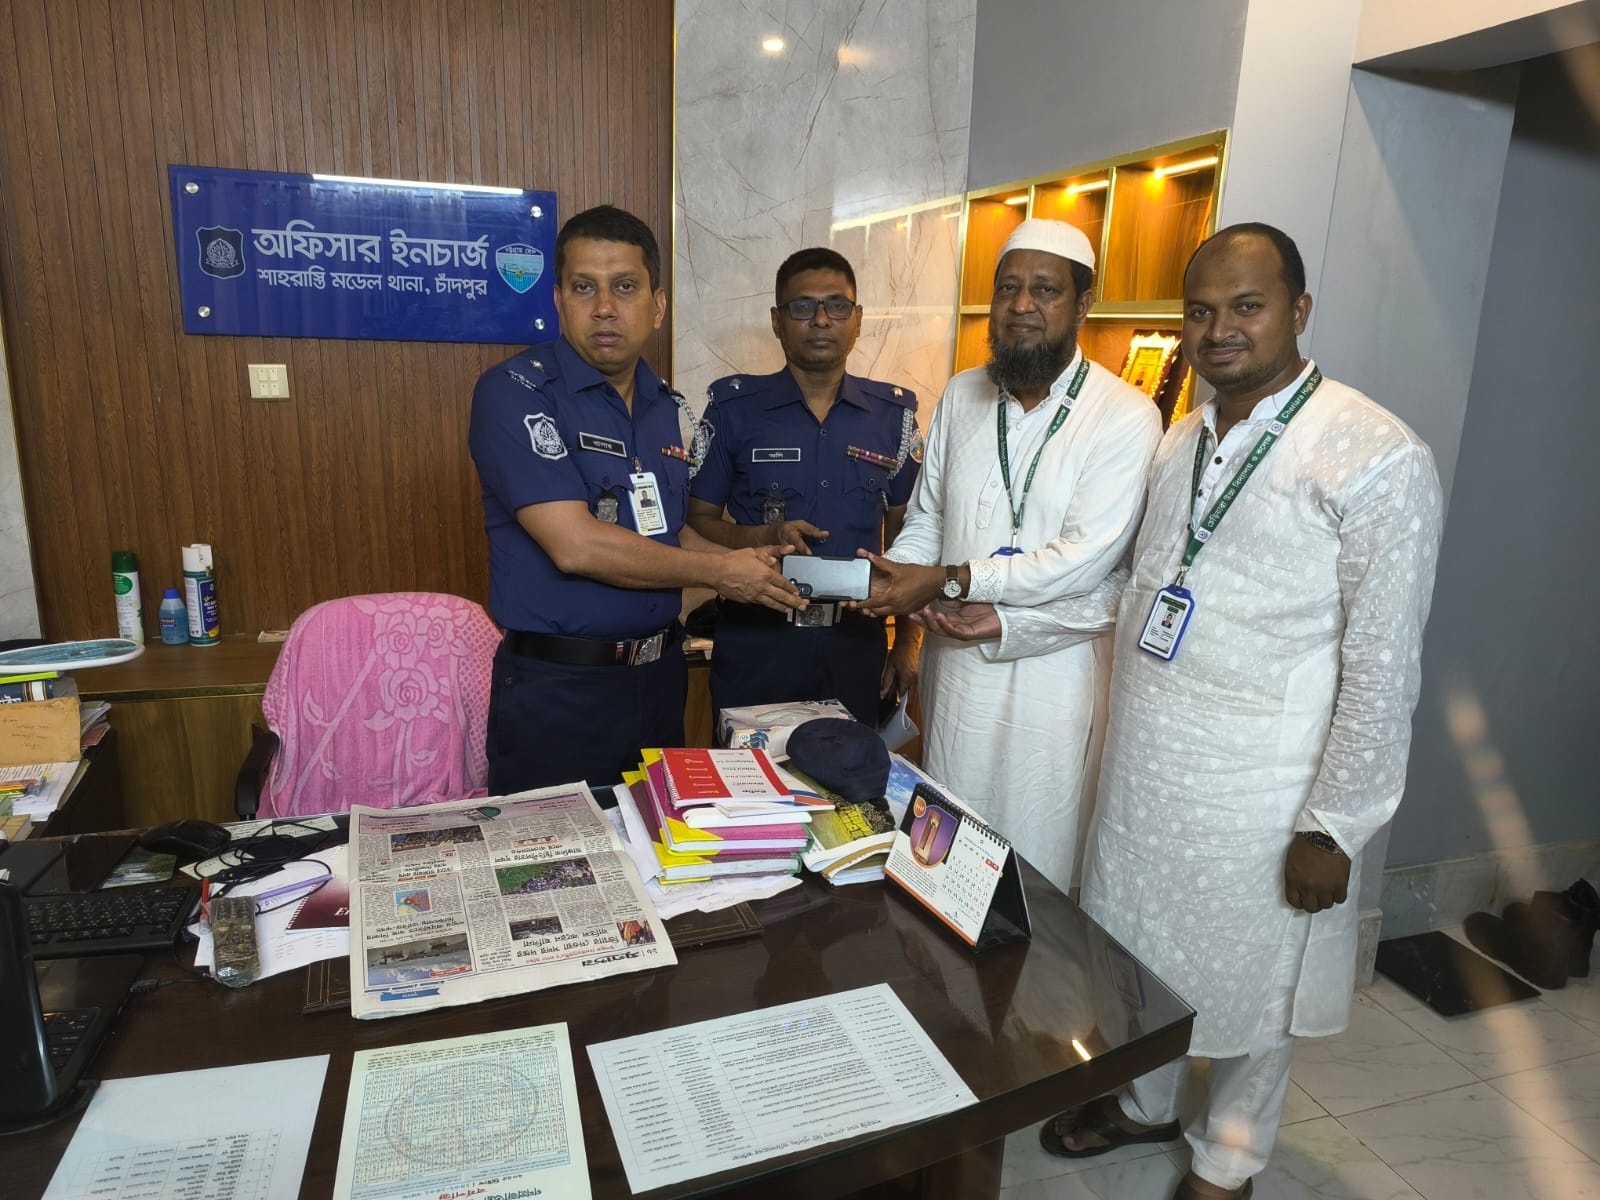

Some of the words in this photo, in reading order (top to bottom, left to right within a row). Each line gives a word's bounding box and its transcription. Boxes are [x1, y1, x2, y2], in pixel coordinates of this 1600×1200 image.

[251, 219, 382, 264] অফিসার
[390, 228, 490, 269] ইনচার্জ
[257, 265, 326, 290] শাহরাস্তি
[330, 272, 382, 291] মডেল
[387, 274, 431, 295] থানা,
[435, 272, 488, 300] চাঁদপুর
[581, 951, 640, 968] যুগান্তর
